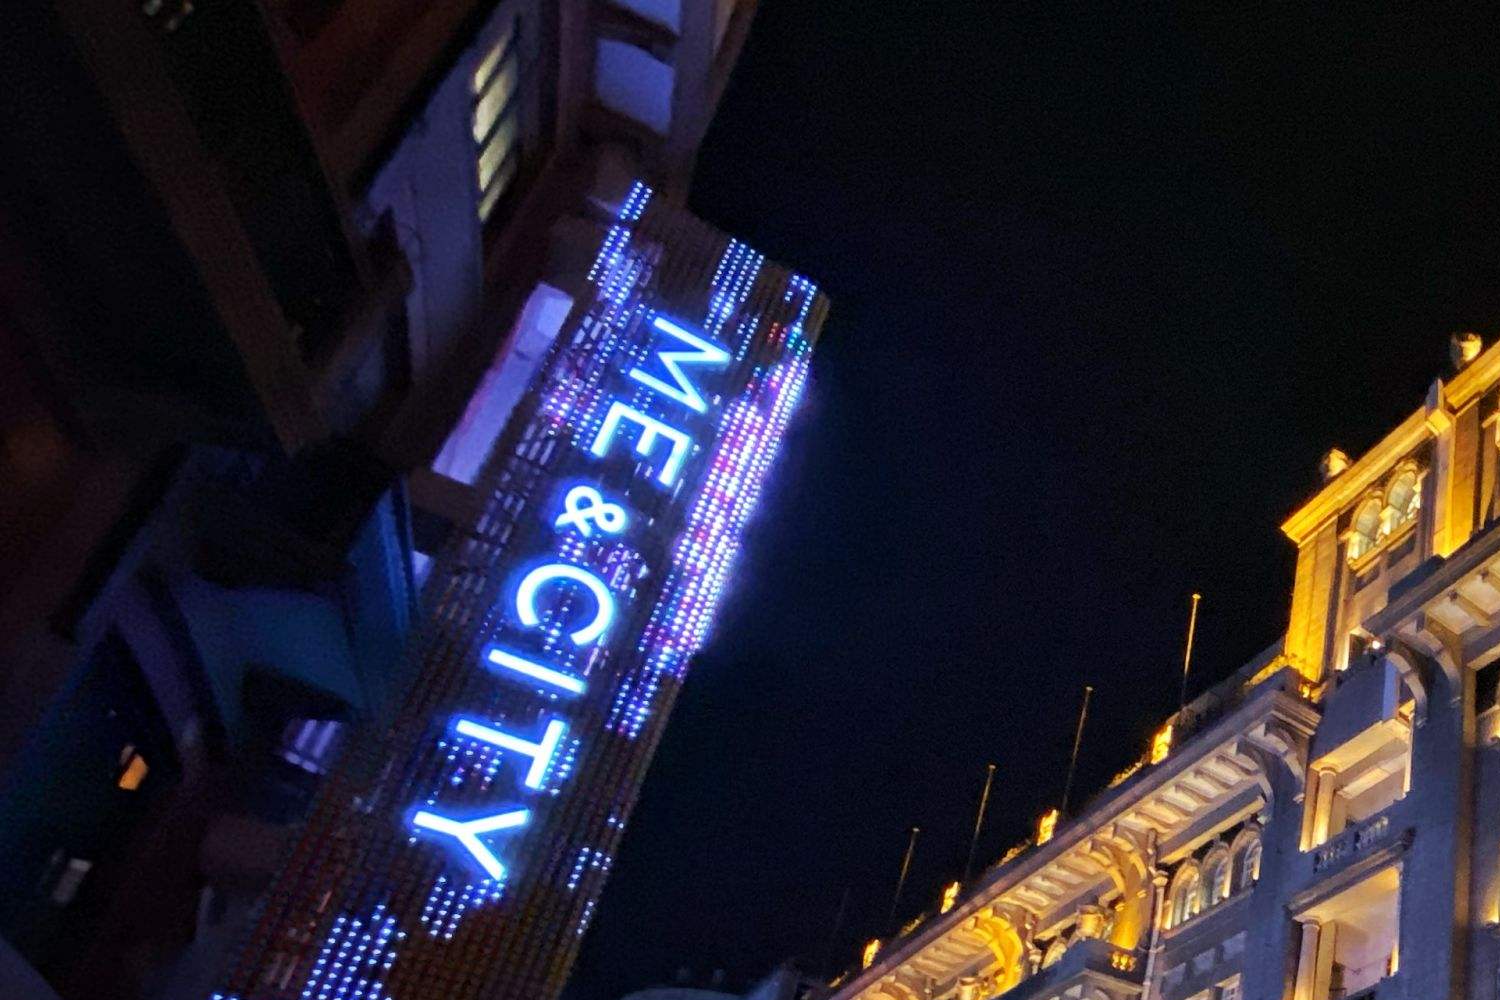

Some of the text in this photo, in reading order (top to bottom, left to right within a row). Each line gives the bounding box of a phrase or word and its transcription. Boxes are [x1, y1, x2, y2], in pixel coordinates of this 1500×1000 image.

[412, 316, 731, 882] ME & CITY
